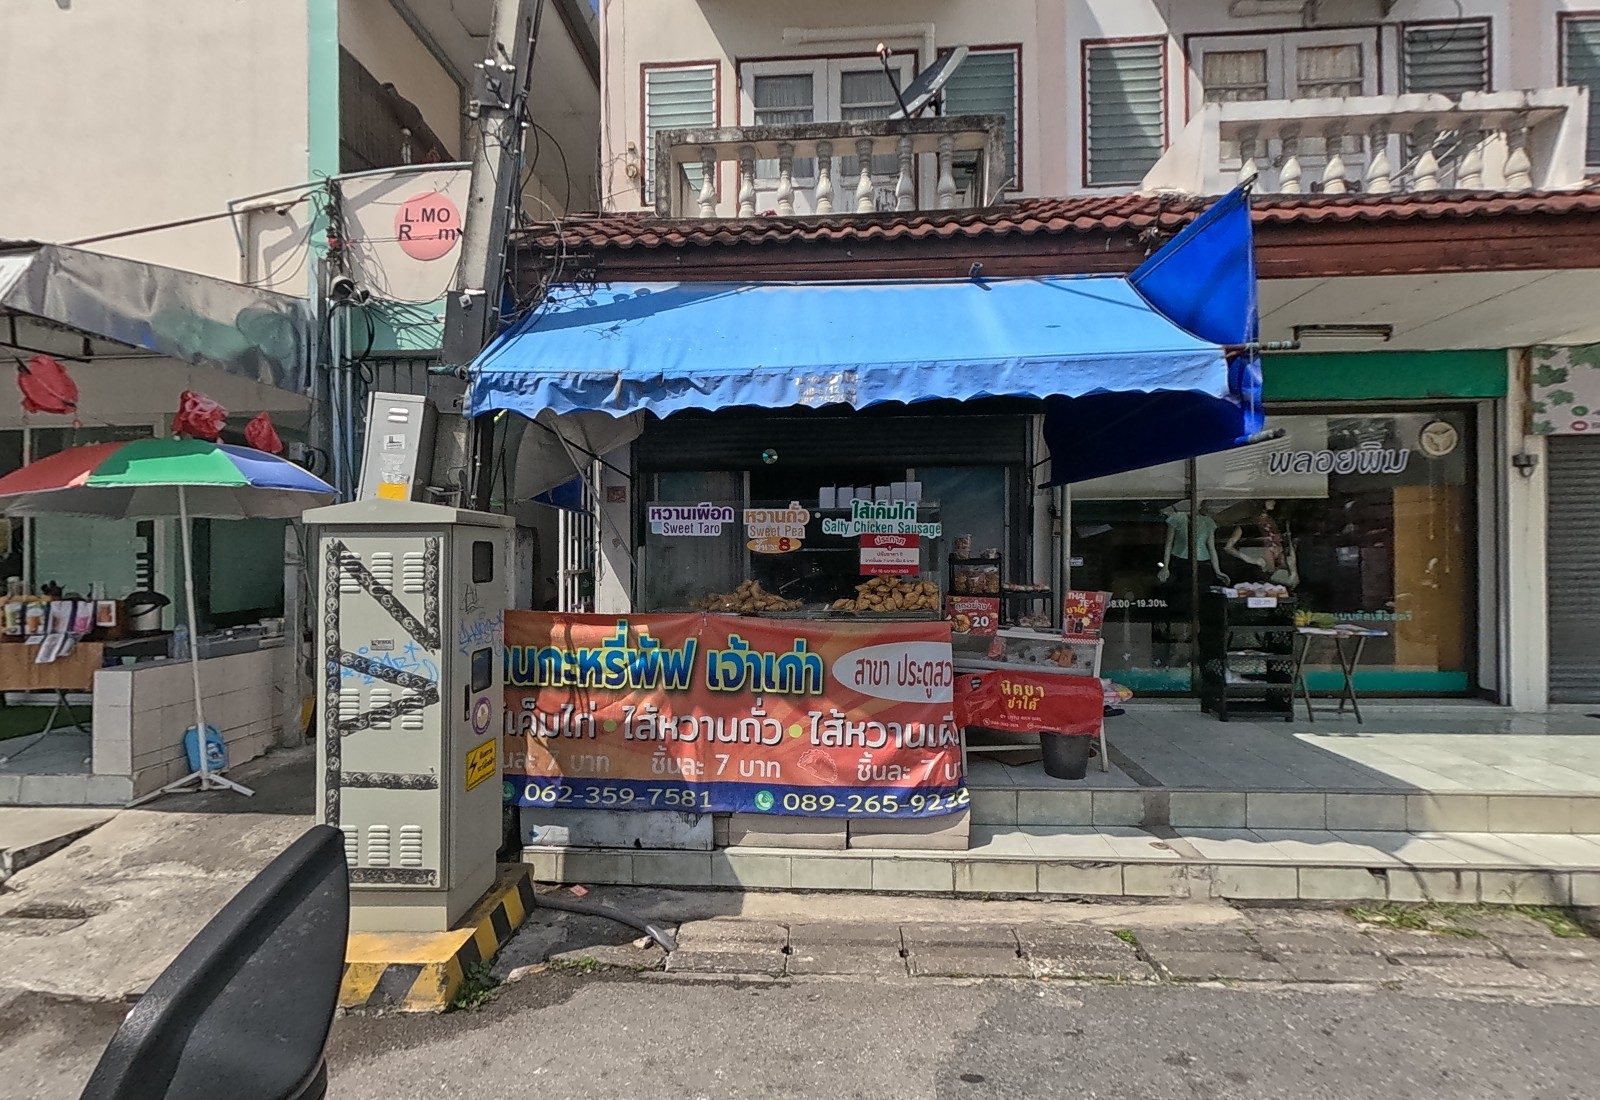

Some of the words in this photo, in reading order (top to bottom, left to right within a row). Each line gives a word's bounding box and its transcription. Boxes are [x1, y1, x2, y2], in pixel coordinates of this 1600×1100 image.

[1269, 441, 1410, 475] พลอยพิม
[650, 502, 733, 521] หวานเผือก
[662, 522, 694, 534] Sweet
[698, 522, 720, 534] Taro
[749, 525, 781, 538] Sweet
[784, 525, 805, 538] Pea
[823, 519, 850, 535] Salty
[853, 520, 894, 534] Chicken
[897, 521, 941, 537] Sausage
[972, 615, 990, 628] 20
[706, 633, 824, 695] เจ้าเก่า
[854, 657, 890, 687] สาขา
[503, 696, 596, 738] เค็มไก่
[622, 696, 783, 745] ไส้หวานถั่ว
[651, 745, 706, 776] ชิ้นละ
[715, 754, 730, 777] 7
[739, 757, 782, 779] บาท
[857, 751, 911, 782] ชิ้นละ
[920, 751, 946, 781] 7
[524, 782, 713, 809] 062-359-7581
